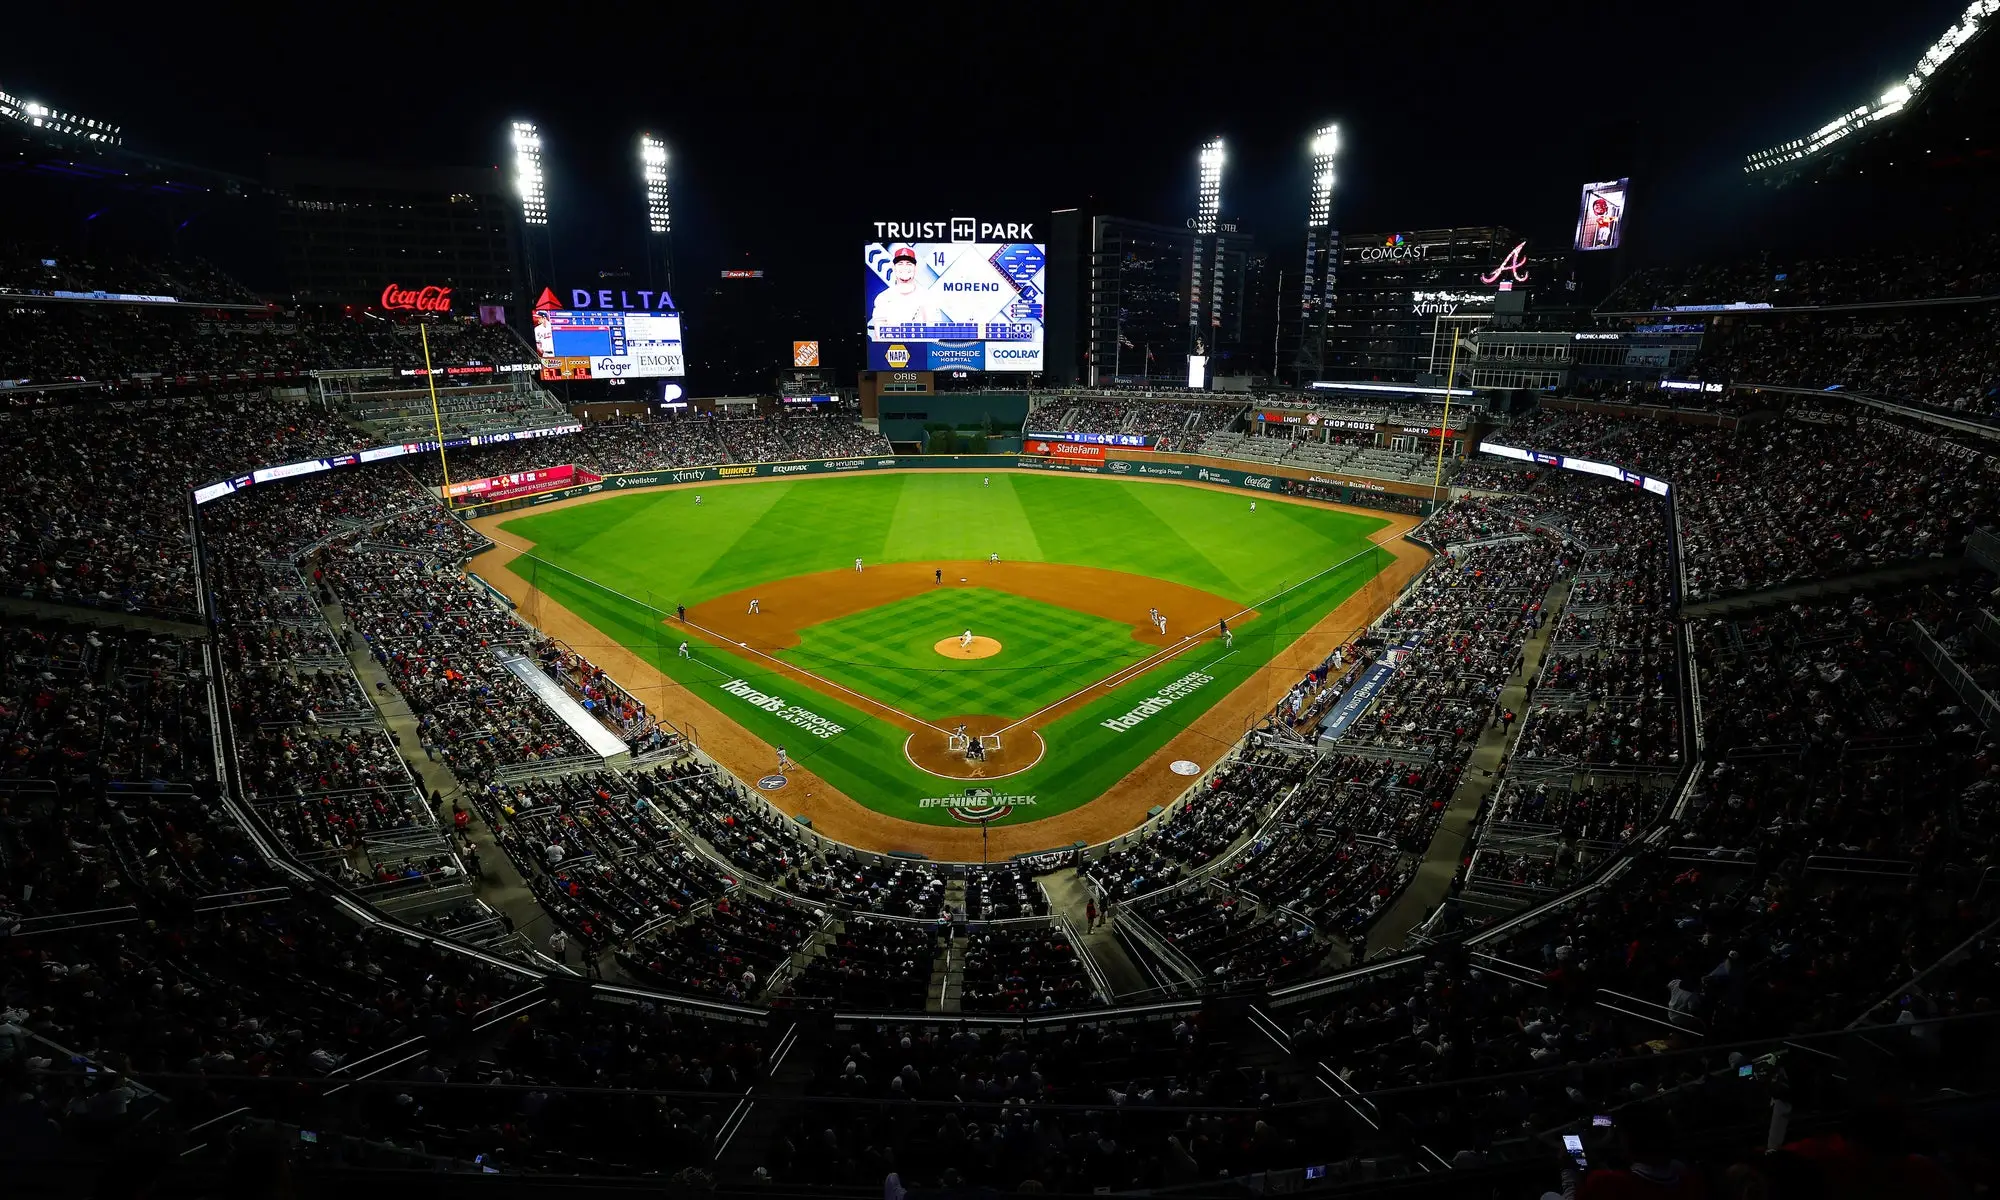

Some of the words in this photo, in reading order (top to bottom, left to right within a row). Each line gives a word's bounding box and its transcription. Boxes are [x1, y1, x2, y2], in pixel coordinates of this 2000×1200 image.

[874, 222, 946, 239] TRUIST
[981, 223, 1034, 240] PARK
[933, 251, 945, 267] 14
[1360, 246, 1429, 260] COMCAST
[943, 282, 999, 292] MORENO
[572, 289, 675, 309] DELTA
[1412, 301, 1459, 316] xfinity
[795, 341, 818, 366] HOME
[890, 351, 907, 361] NAPA
[993, 350, 1039, 359] COOLRAY
[598, 357, 631, 376] Kroger
[640, 355, 680, 366] EMORY
[543, 368, 555, 377] 67
[1324, 419, 1344, 428] CHOP
[1347, 421, 1375, 430] HOUSE
[1056, 443, 1100, 455] StateFarm
[719, 467, 757, 475] QUIKRETE
[772, 464, 807, 473] EQUIFAX
[1112, 463, 1128, 471] Ford
[1147, 467, 1167, 475] Georgia
[627, 477, 658, 485] Wellstar
[673, 470, 705, 482] xfinity
[1157, 671, 1203, 696] CHEROKEE
[1169, 674, 1214, 700] CASINOS
[776, 710, 833, 739] CASINOS
[788, 706, 845, 734] CHEROKEE
[919, 797, 987, 808] OPENING
[992, 795, 1037, 806] WEEK
